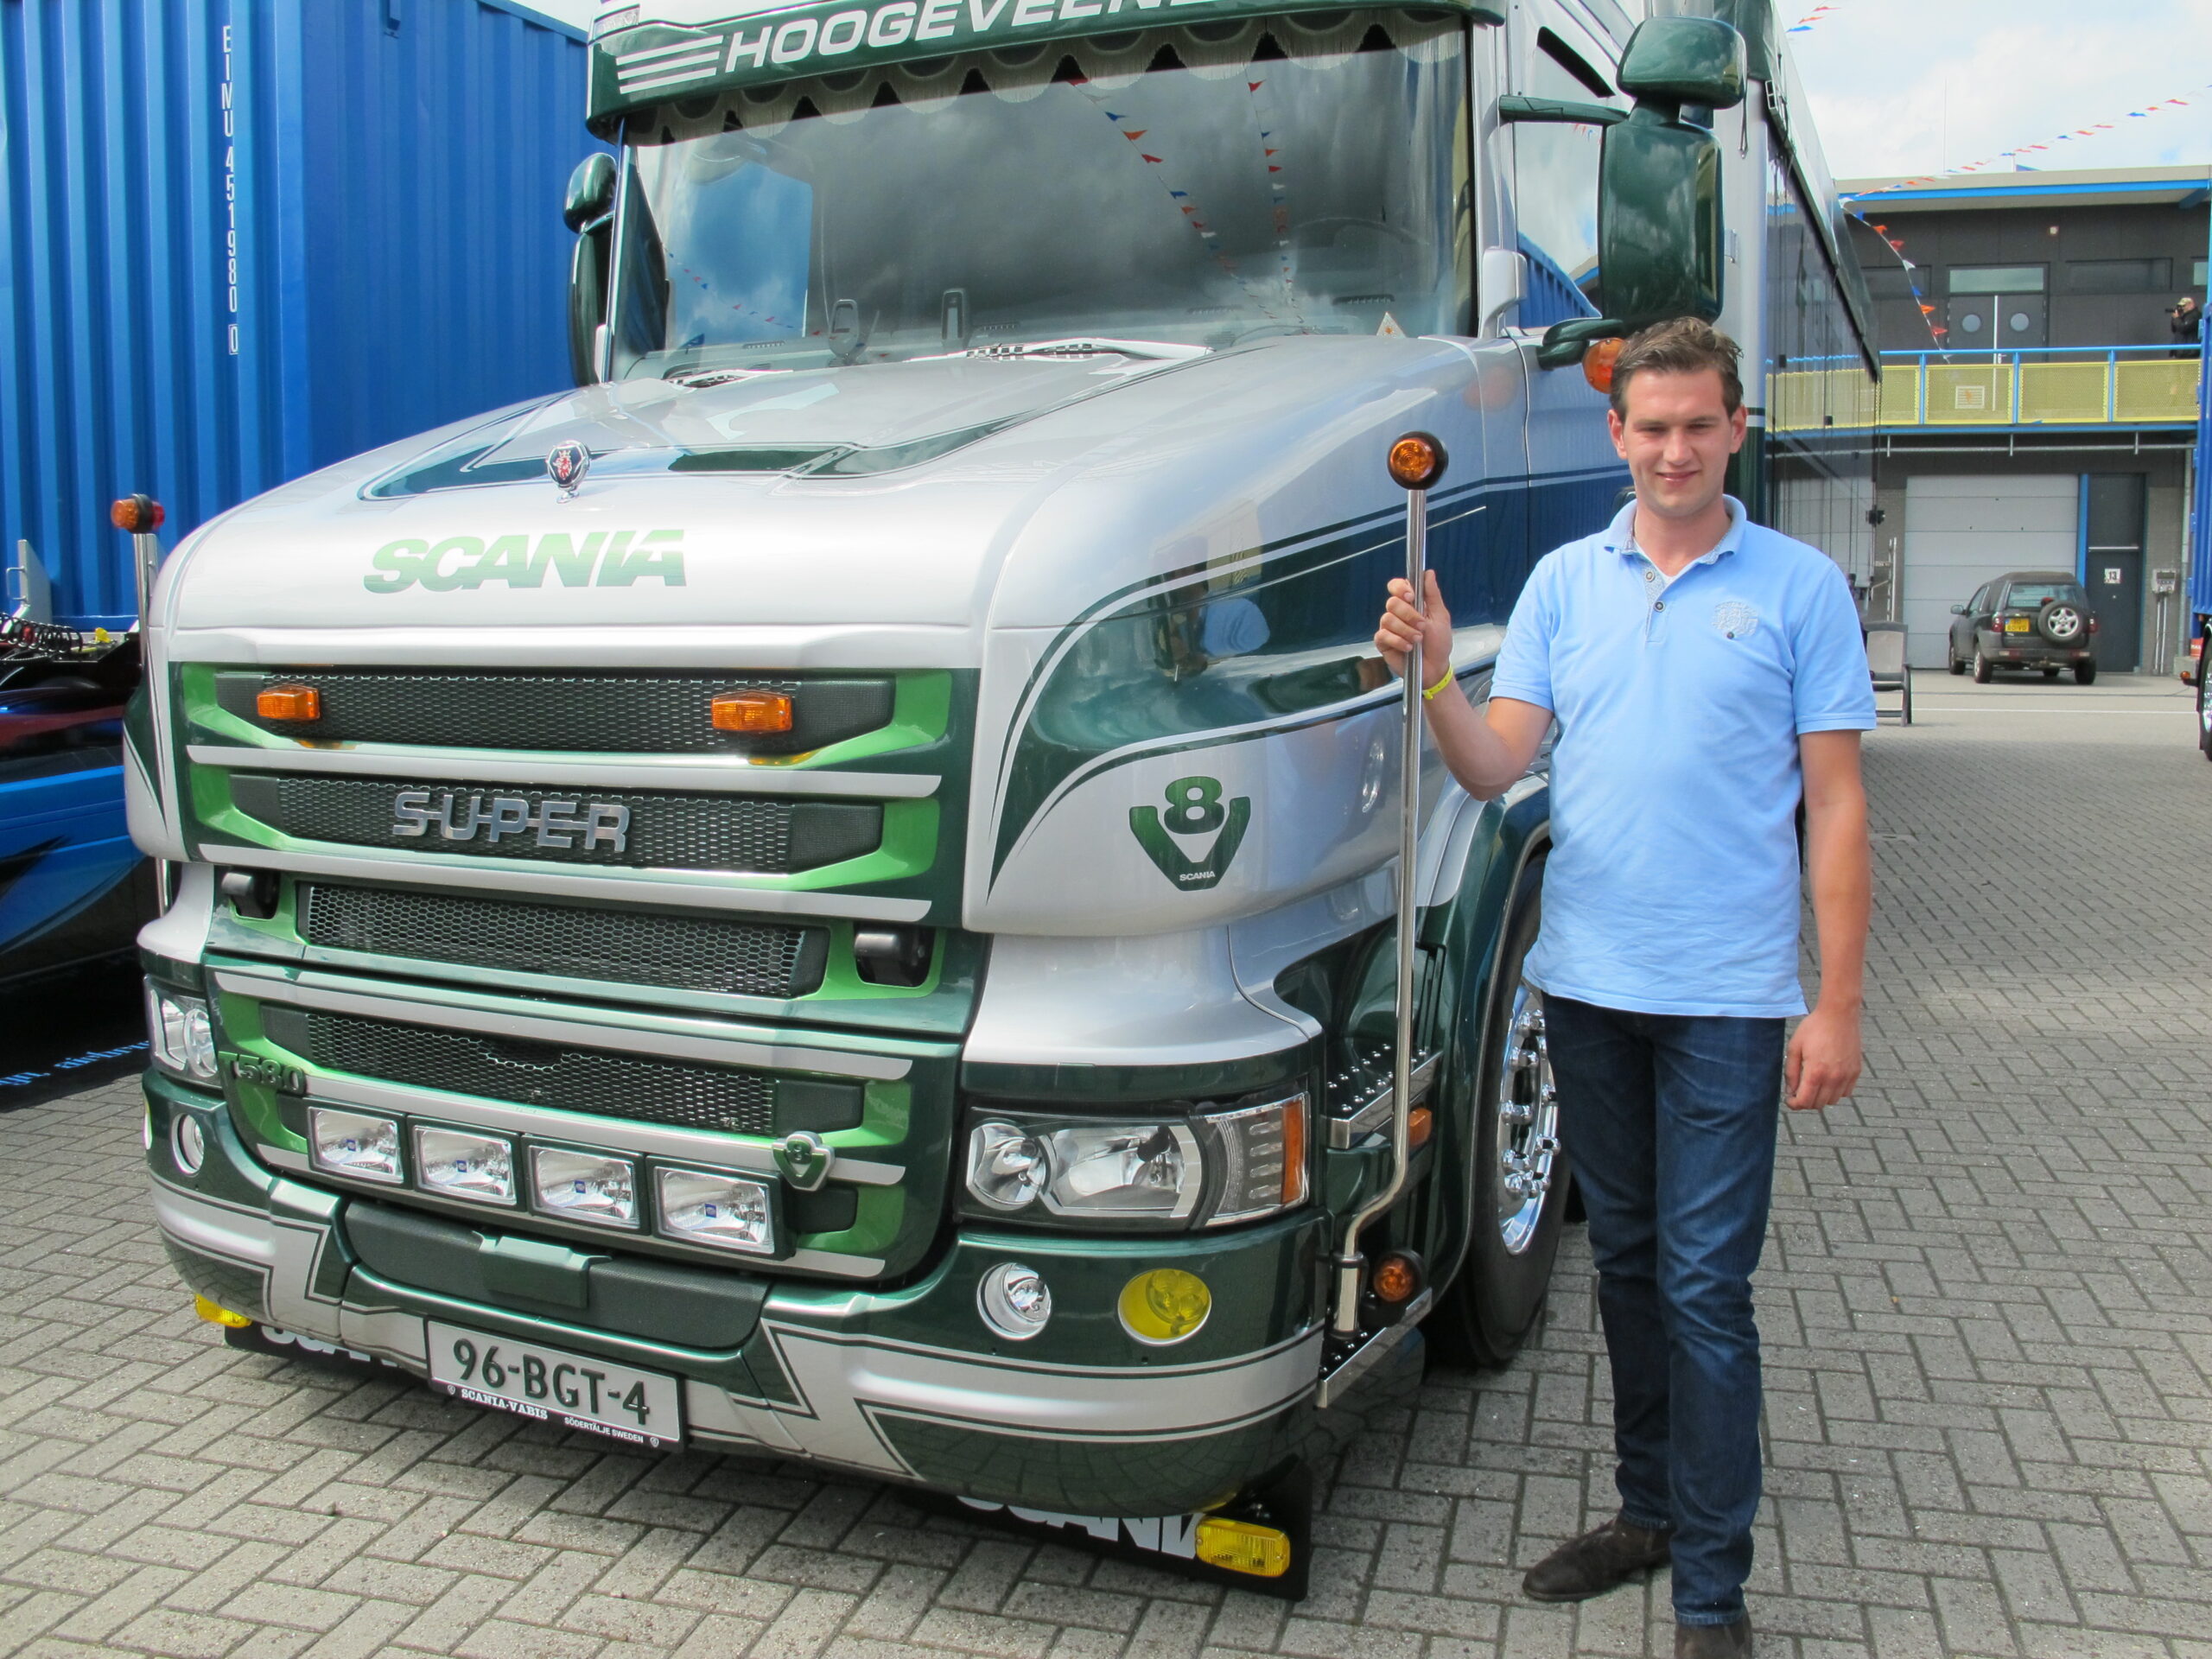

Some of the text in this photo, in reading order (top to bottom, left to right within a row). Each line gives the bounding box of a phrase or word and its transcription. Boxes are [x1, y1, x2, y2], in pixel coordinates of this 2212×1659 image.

[226, 146, 237, 313] 451980
[363, 529, 687, 594] SCANIA
[391, 791, 631, 853] SUPER
[1179, 870, 1216, 881] SCANIA
[218, 1051, 307, 1094] T580
[453, 1338, 650, 1426] 96-BGT-4
[564, 1416, 644, 1444] SÖDERTÄLJE SWEDEN
